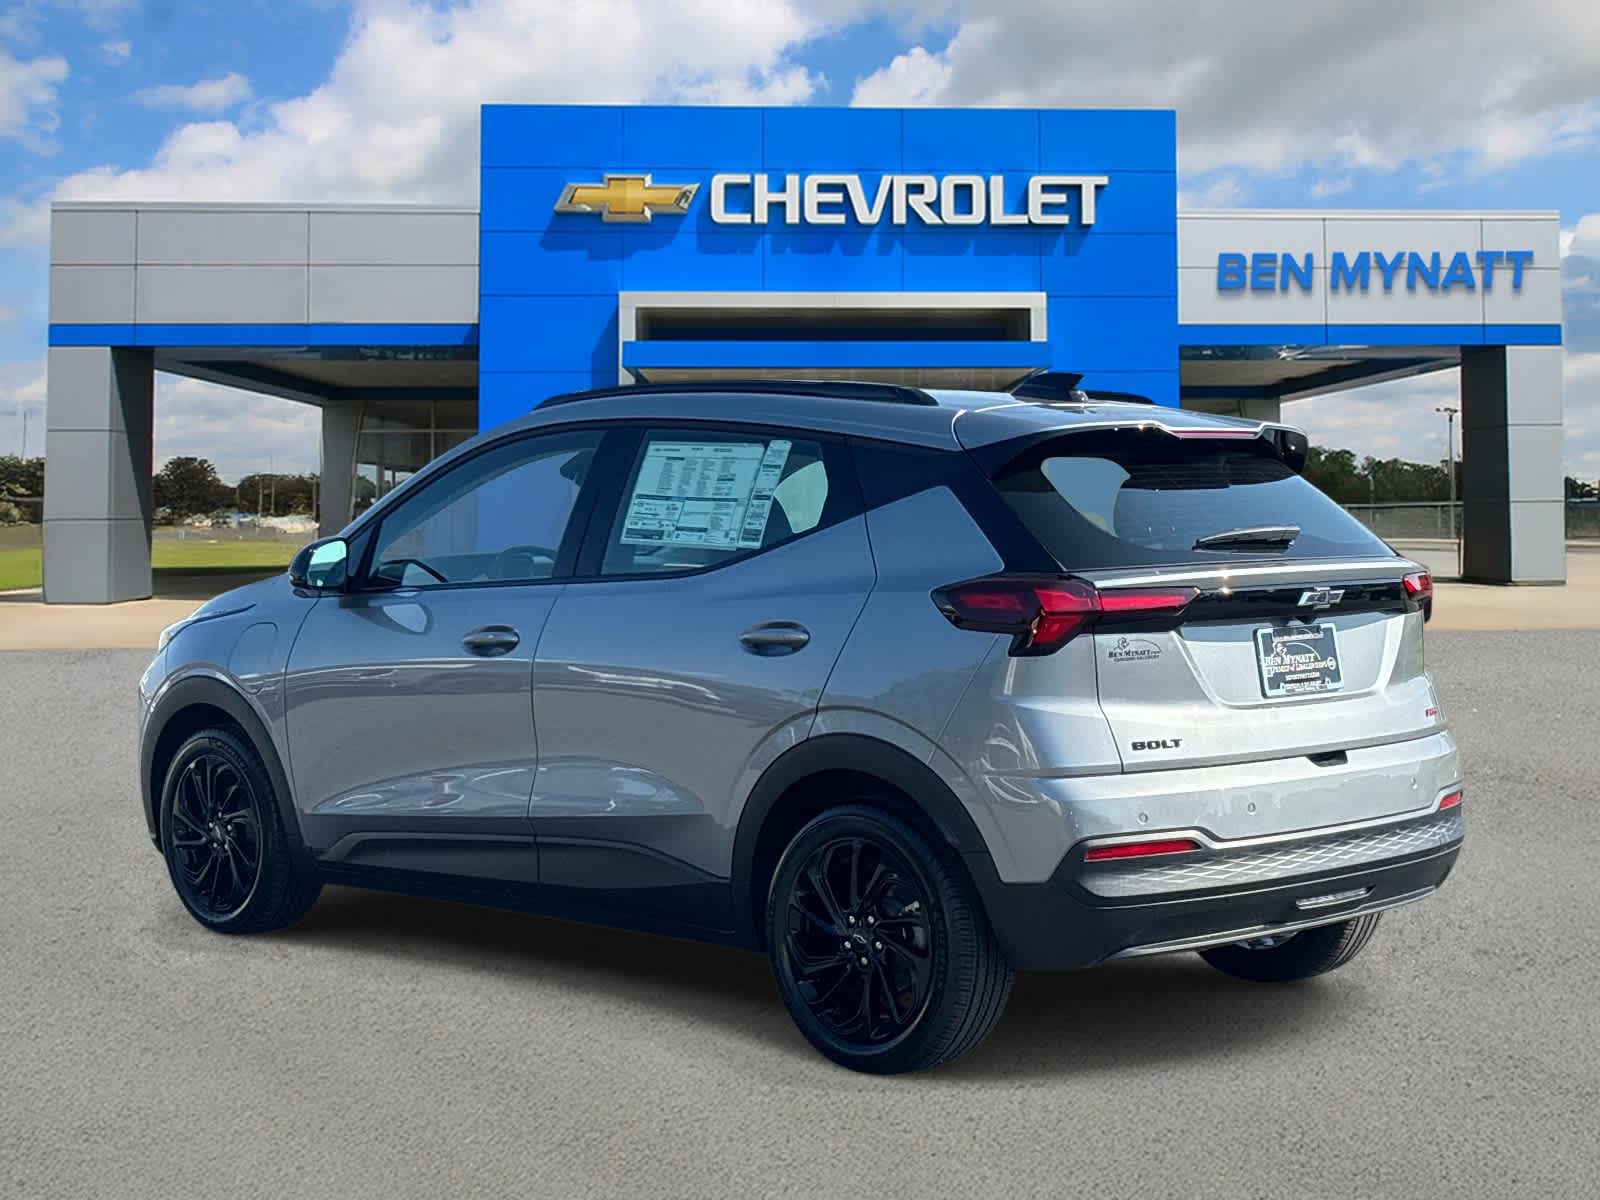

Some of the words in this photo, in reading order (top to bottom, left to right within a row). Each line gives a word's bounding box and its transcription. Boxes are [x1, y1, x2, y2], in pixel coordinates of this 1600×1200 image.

[710, 174, 1109, 226] CHEVROLET
[1217, 252, 1313, 291] BEN
[1330, 250, 1534, 290] MYNATT
[1282, 653, 1315, 664] MYNATT
[1131, 738, 1183, 751] BOLT
